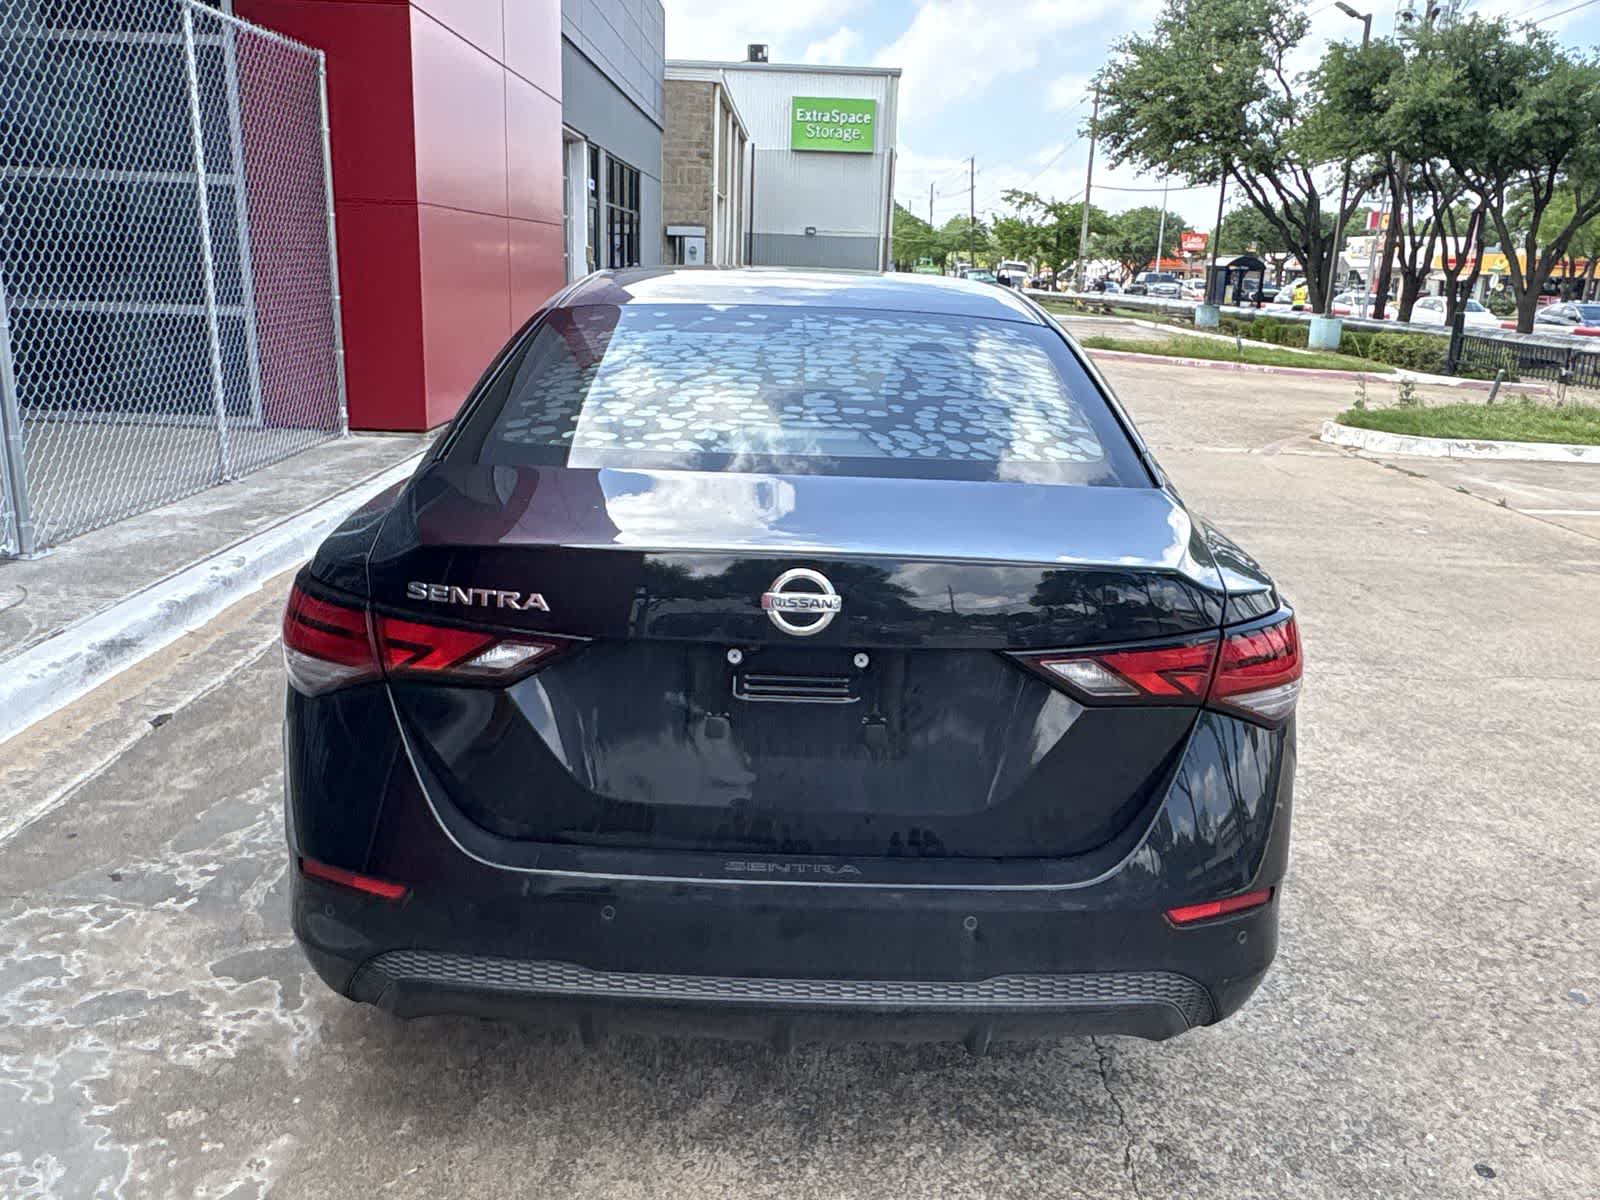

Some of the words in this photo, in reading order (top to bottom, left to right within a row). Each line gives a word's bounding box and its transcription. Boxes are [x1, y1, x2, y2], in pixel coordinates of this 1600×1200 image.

[806, 124, 862, 141] Storage
[406, 581, 550, 611] SENTRA
[770, 597, 832, 609] NISSAN
[724, 860, 862, 875] SENTRA
